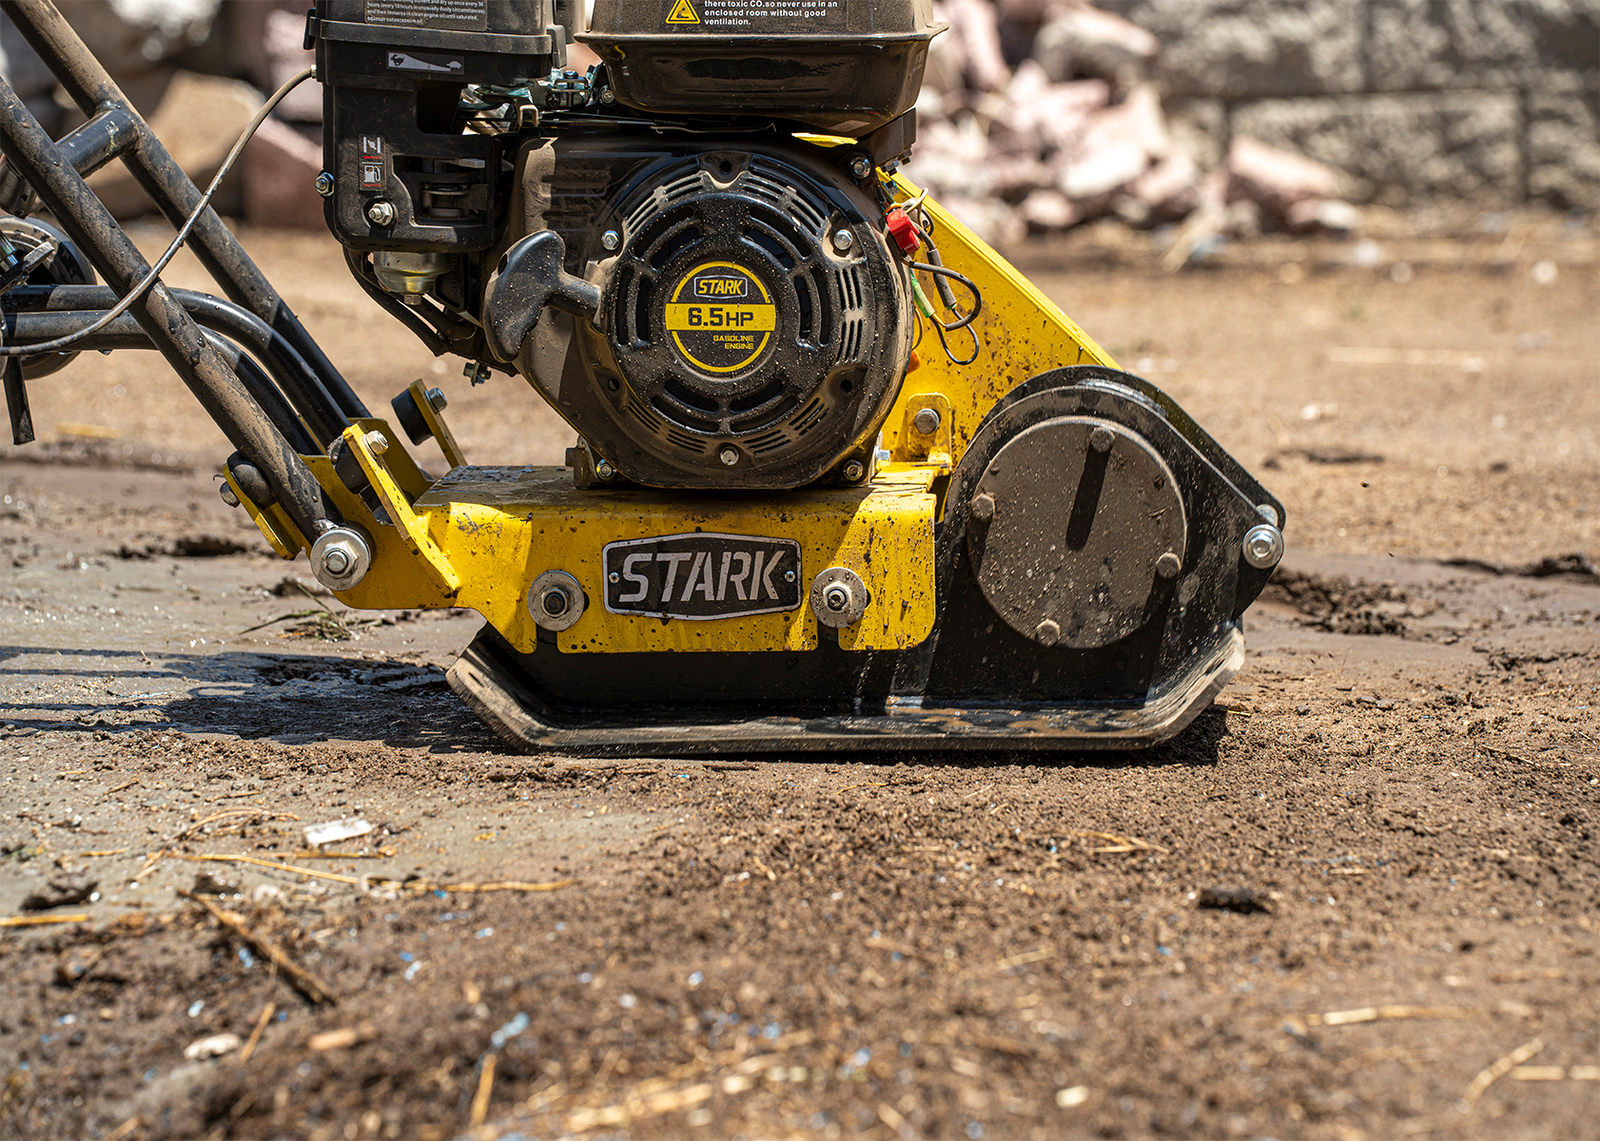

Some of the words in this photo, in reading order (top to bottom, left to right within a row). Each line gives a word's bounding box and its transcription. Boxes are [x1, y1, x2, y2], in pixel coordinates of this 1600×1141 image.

[804, 9, 826, 18] good
[698, 280, 744, 295] STARK
[618, 550, 786, 603] STARK
